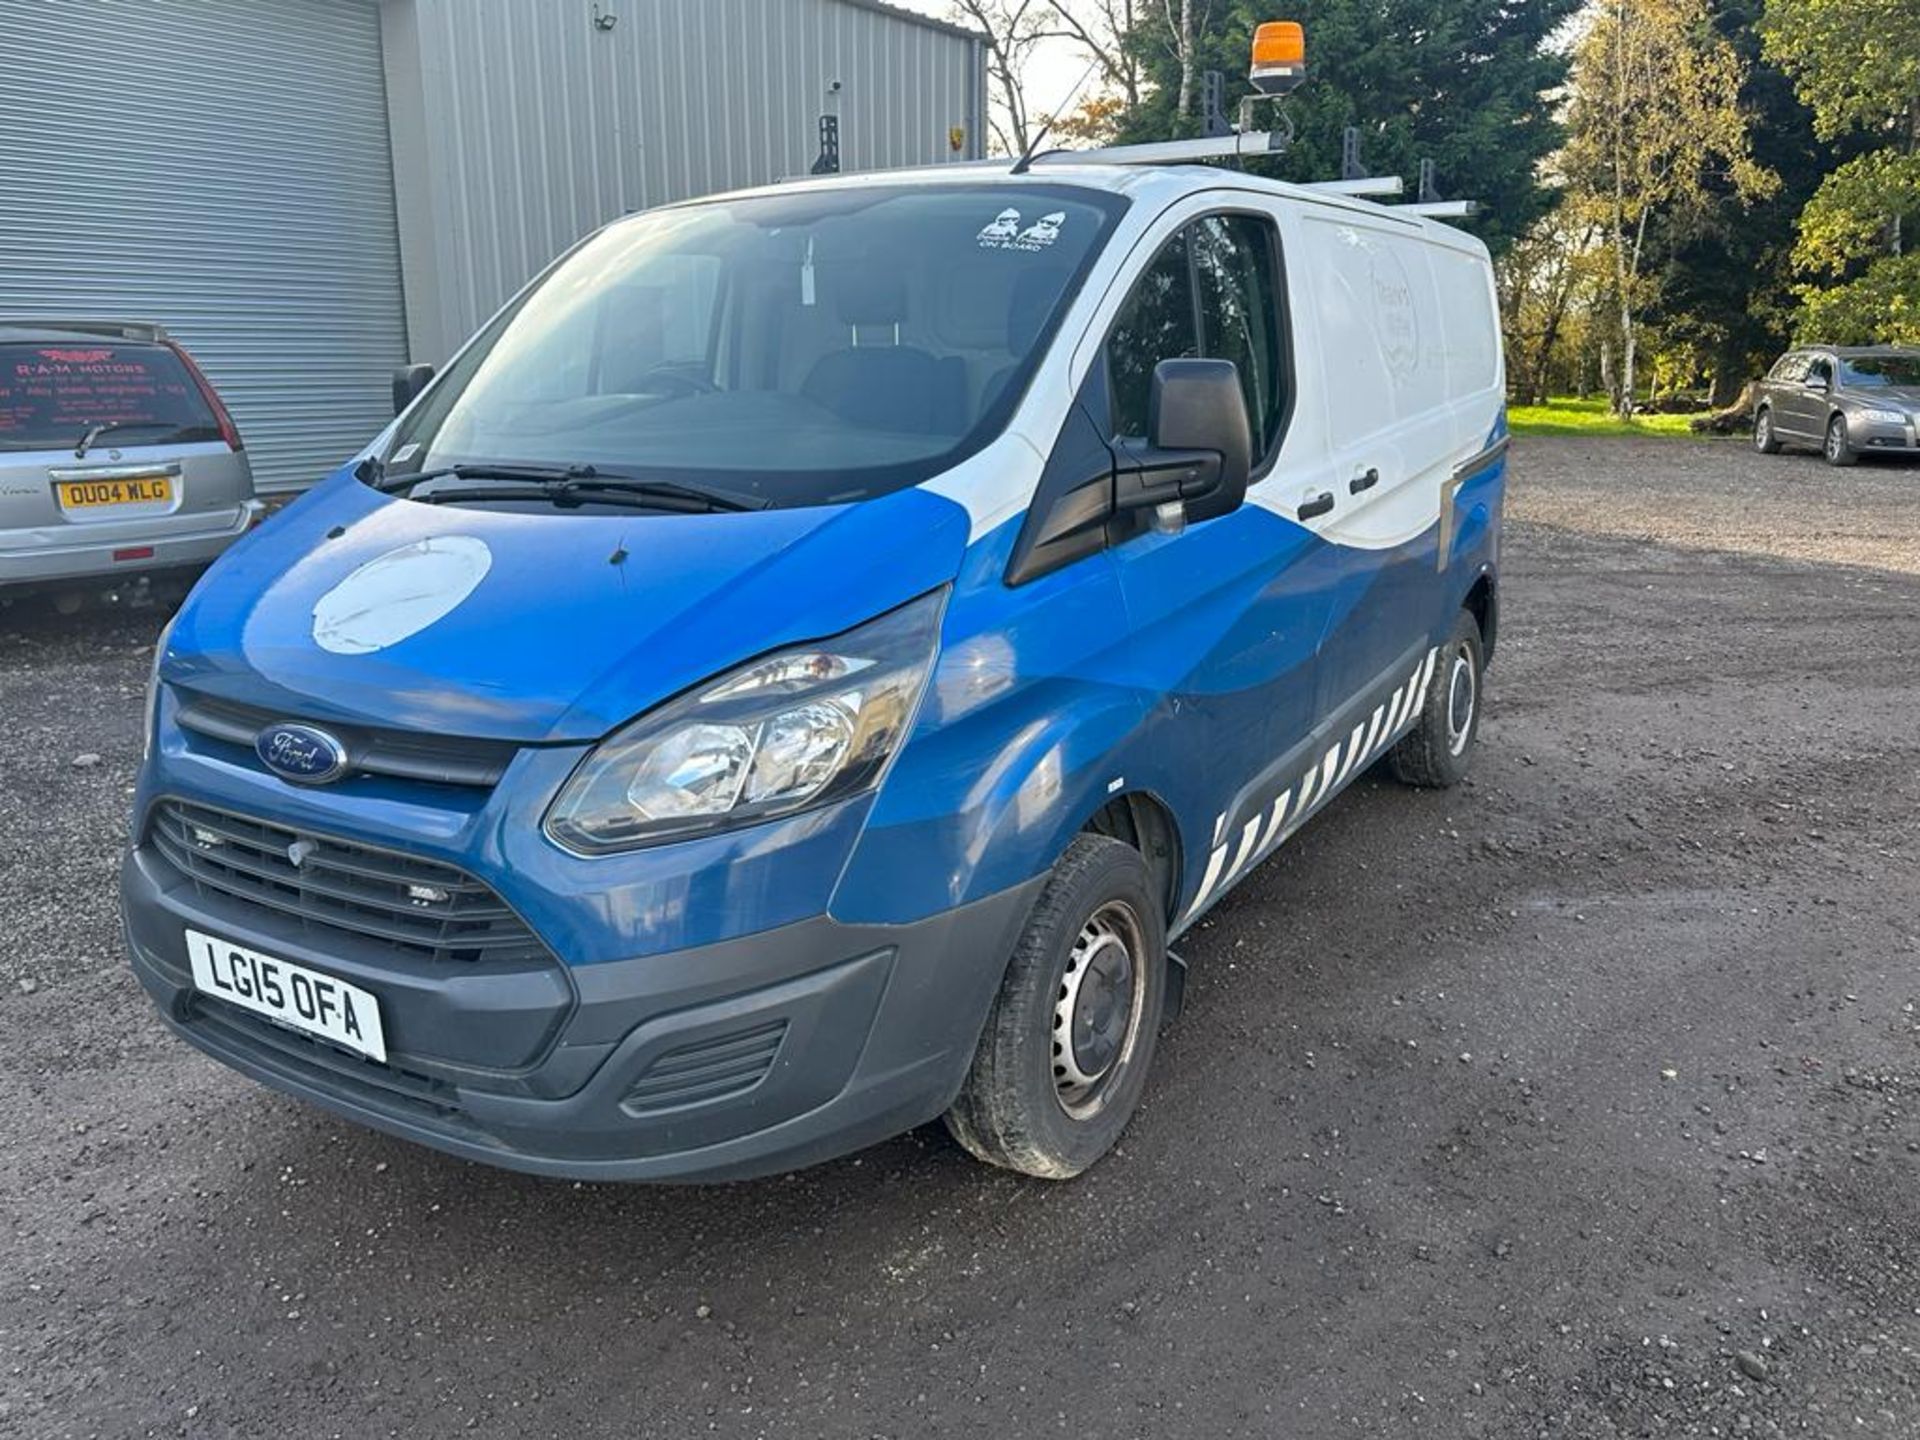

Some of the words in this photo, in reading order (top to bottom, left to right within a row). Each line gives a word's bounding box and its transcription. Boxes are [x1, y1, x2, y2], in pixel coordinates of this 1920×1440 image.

[79, 364, 145, 374] MOTORS
[70, 487, 122, 504] OU04
[126, 481, 164, 499] WLG
[270, 732, 318, 770] Ford
[207, 943, 284, 1009] LG15
[291, 973, 363, 1041] OFA
